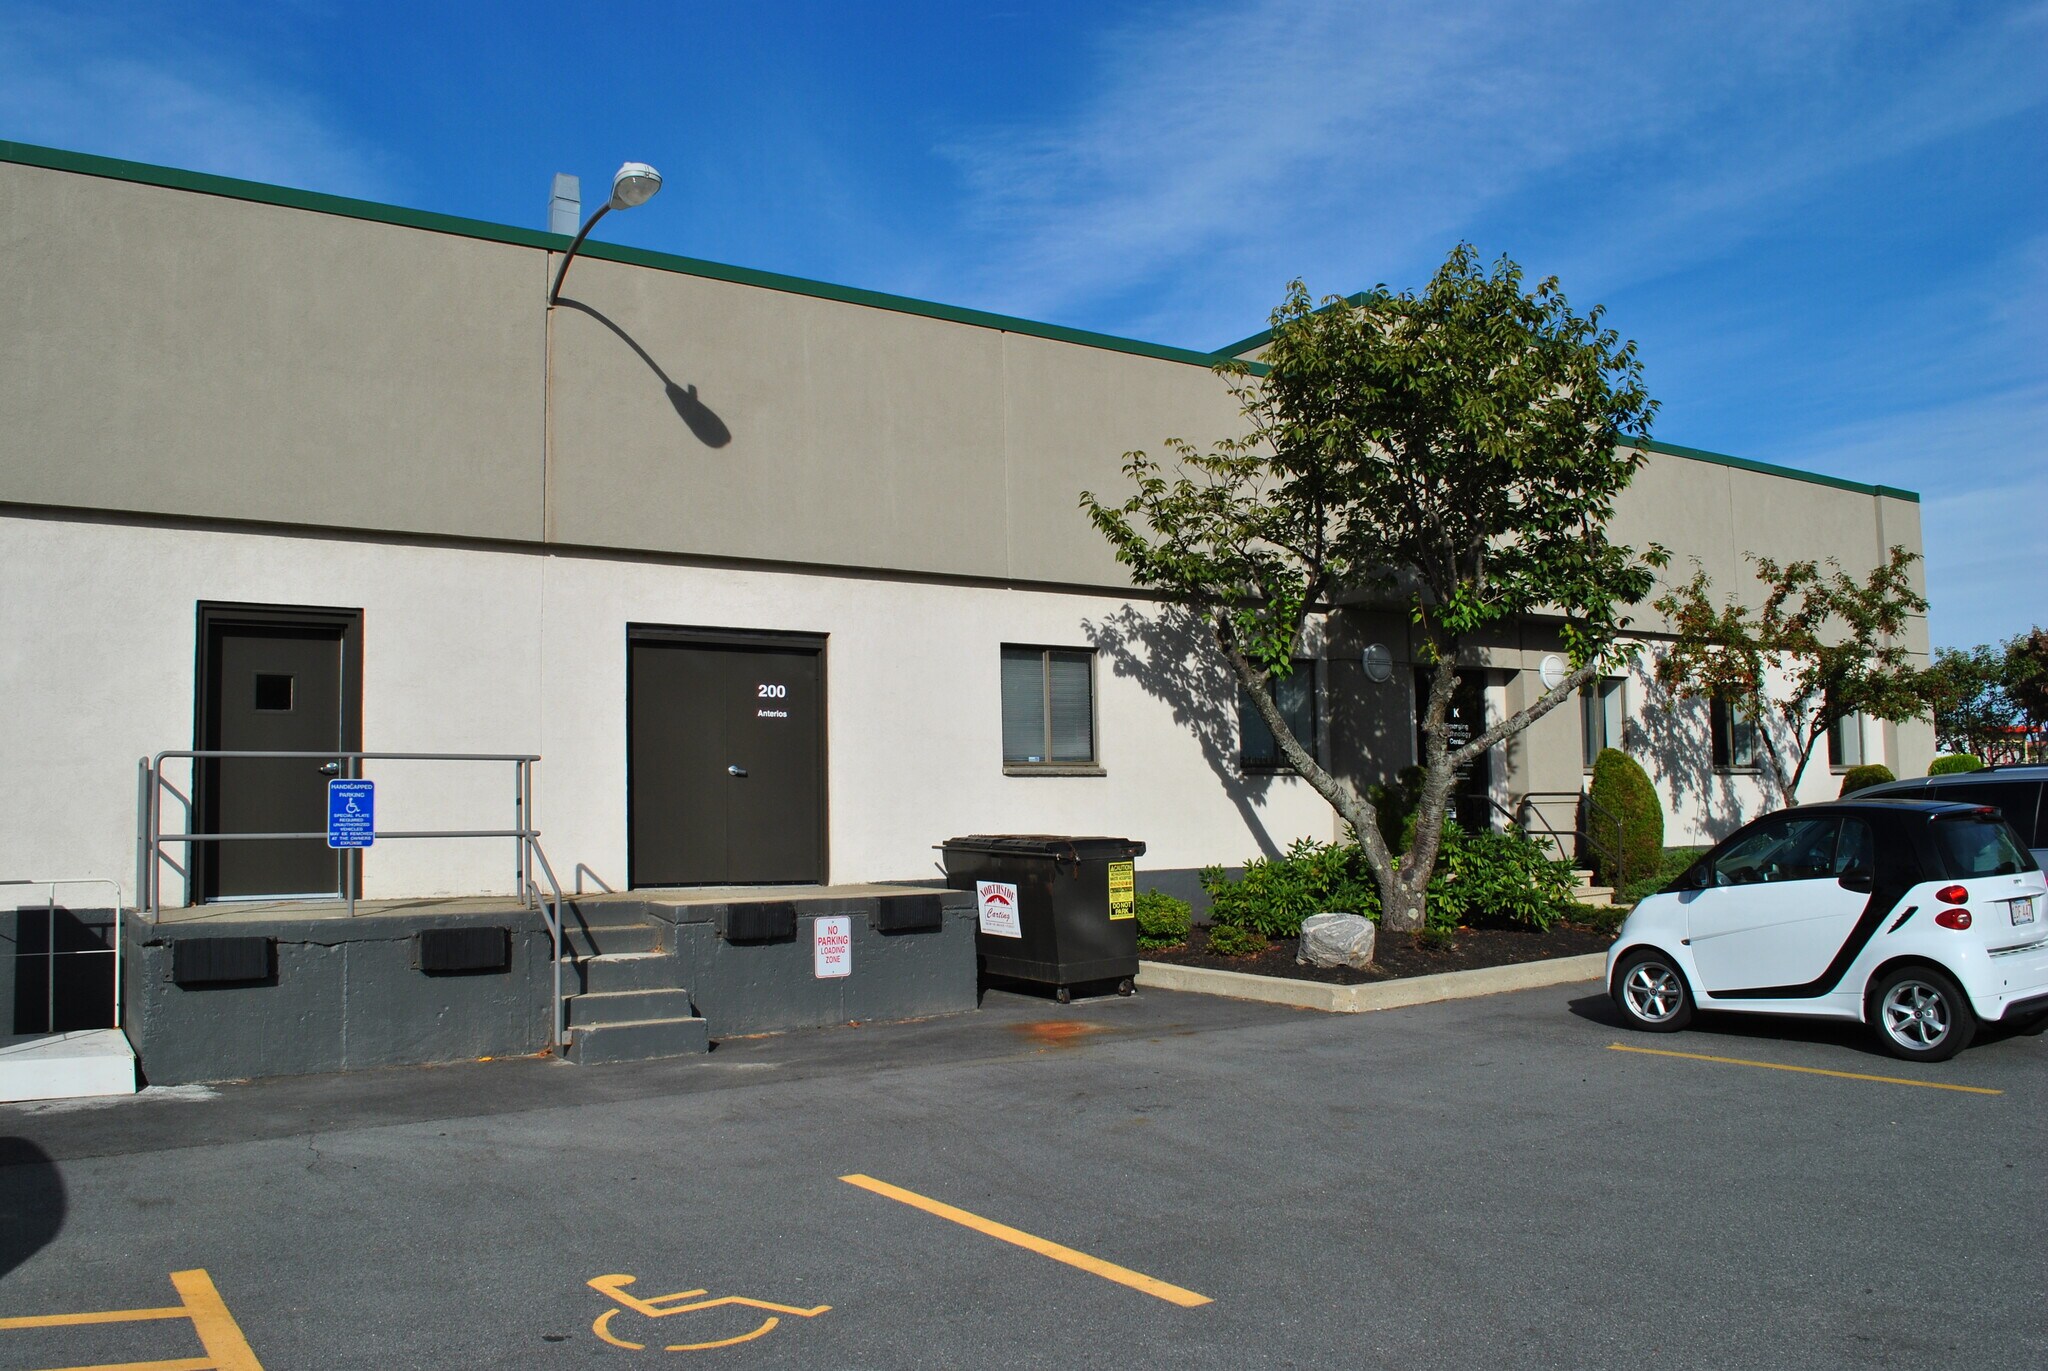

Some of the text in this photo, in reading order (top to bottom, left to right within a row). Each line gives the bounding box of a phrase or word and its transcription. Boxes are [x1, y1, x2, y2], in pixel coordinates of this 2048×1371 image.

[758, 684, 786, 698] 200
[757, 709, 788, 718] Anterios
[1453, 707, 1460, 718] K
[980, 884, 1015, 902] NORTHSIDE
[986, 907, 1010, 922] Carting
[1115, 907, 1129, 915] PARK
[827, 925, 839, 935] NO
[817, 935, 849, 946] PARKING
[820, 945, 846, 955] LOADING
[825, 955, 841, 964] ZONE
